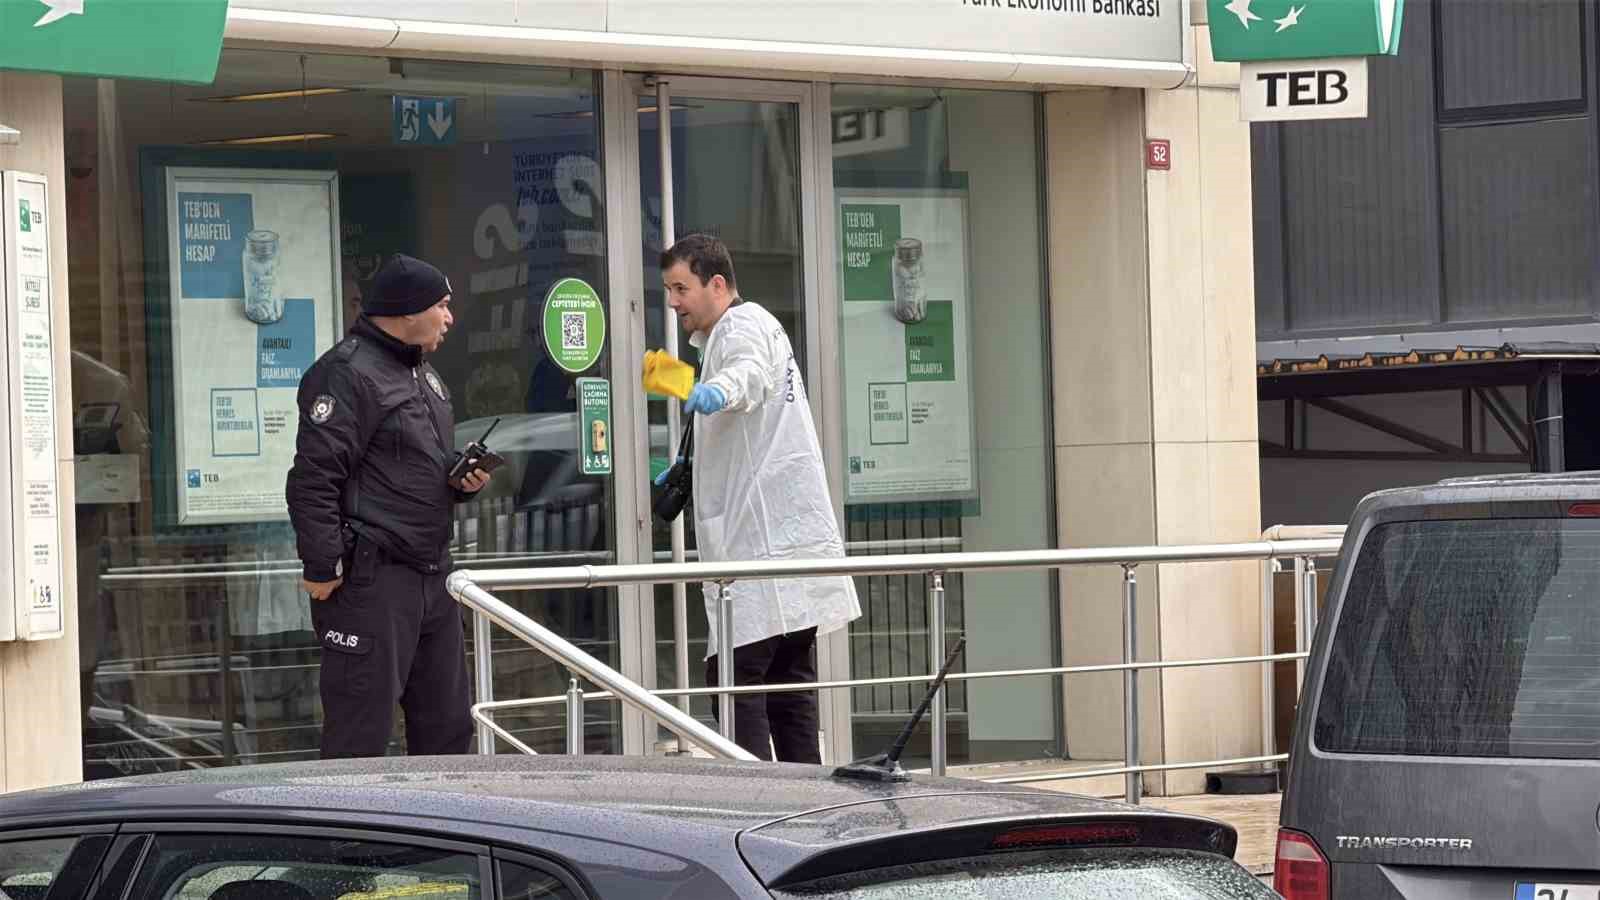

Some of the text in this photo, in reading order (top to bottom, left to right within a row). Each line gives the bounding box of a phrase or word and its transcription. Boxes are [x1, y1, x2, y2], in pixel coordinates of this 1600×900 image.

[1256, 69, 1349, 107] TEB
[1153, 146, 1167, 162] 52
[183, 199, 222, 218] TEB'DEN
[845, 211, 875, 229] TEB'DEN
[184, 219, 232, 241] MARİFETLİ
[186, 245, 217, 264] HESAP
[847, 251, 872, 268] HESAP
[863, 460, 876, 469] TEB
[204, 474, 220, 483] TEB
[1335, 835, 1473, 850] TRANSPORTER
